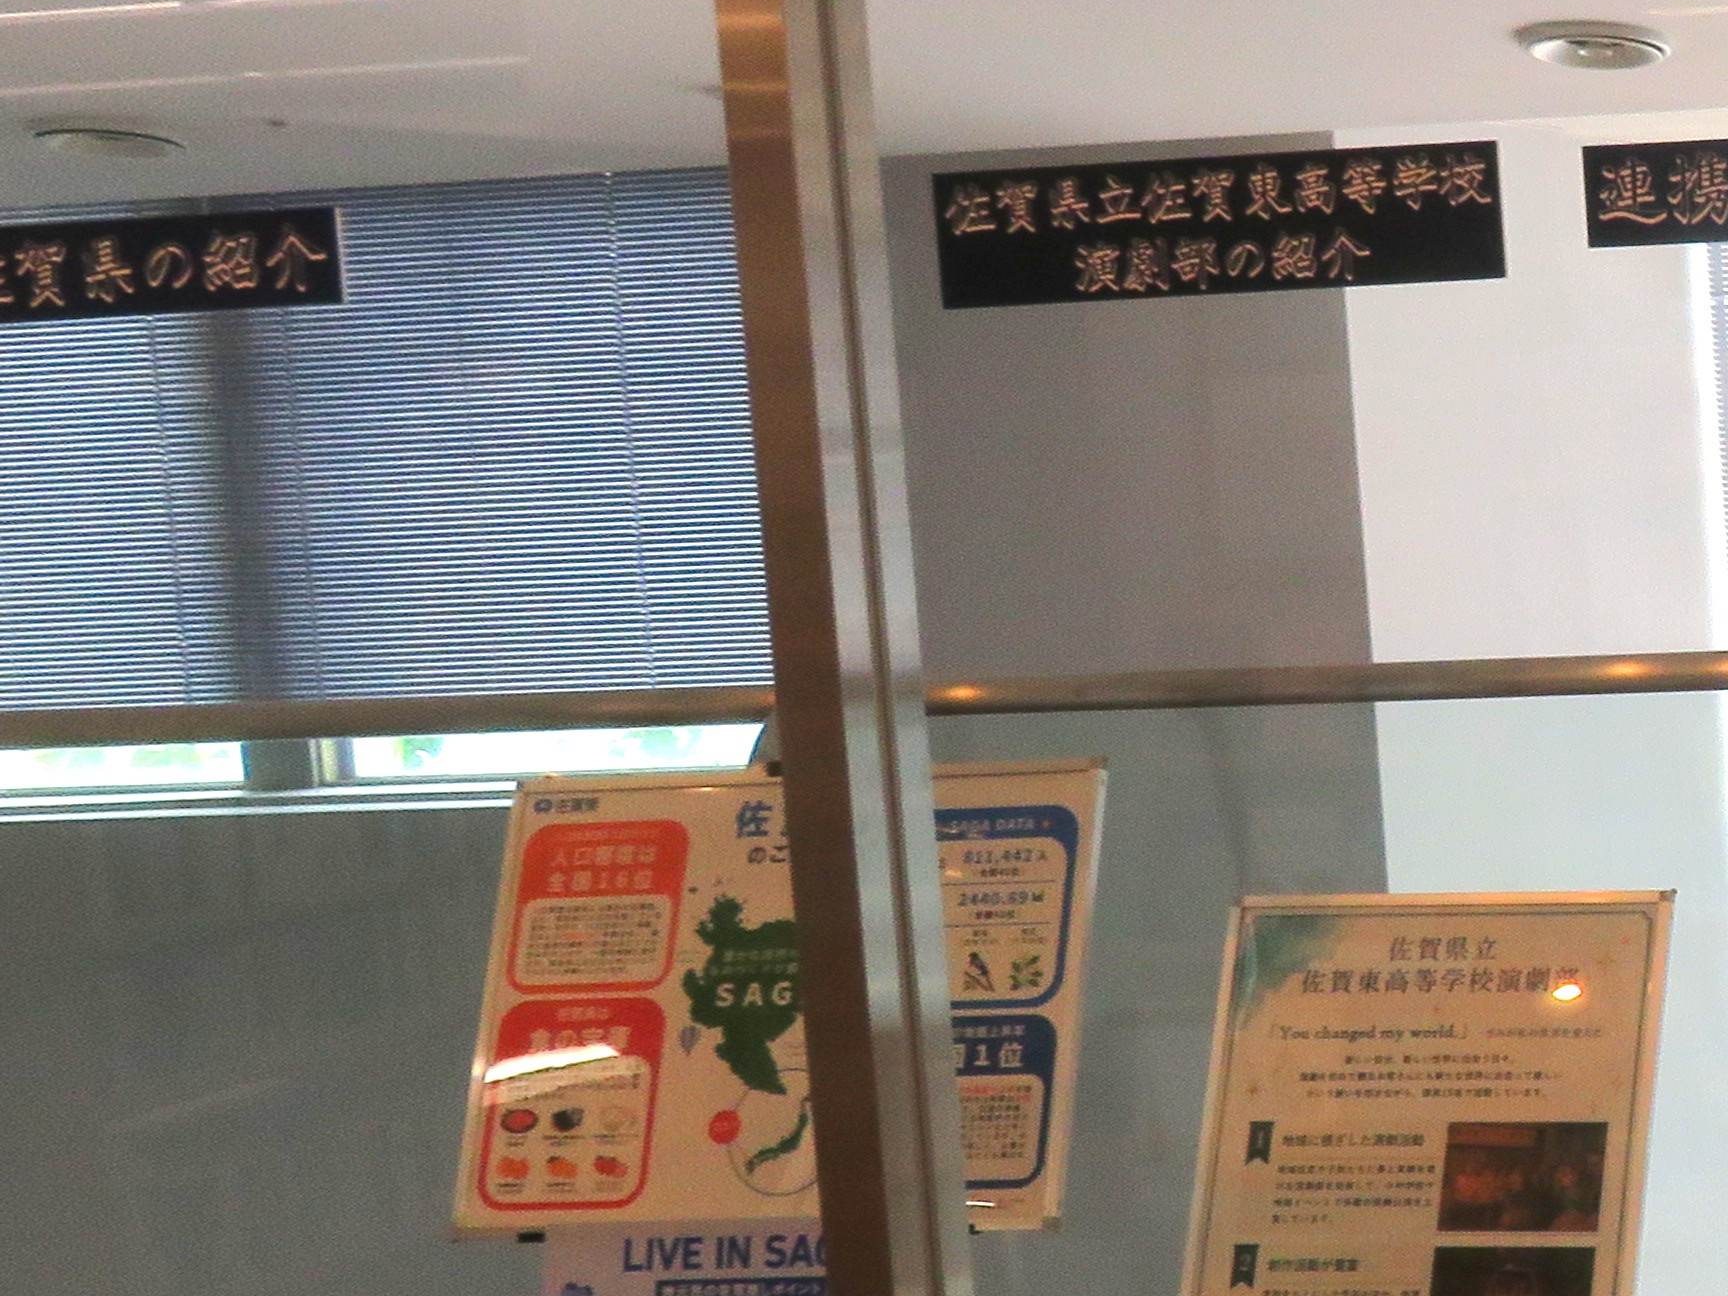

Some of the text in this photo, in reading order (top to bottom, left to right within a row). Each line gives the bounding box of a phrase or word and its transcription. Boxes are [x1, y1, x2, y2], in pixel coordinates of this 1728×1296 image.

[947, 154, 1493, 239] 佐賀県立佐賀東高等学校
[0, 229, 328, 309] 賀県の紹介
[1074, 233, 1372, 294] 演劇部の紹介
[1389, 936, 1496, 962] 佐賀県立
[1315, 1024, 1376, 1043] changed
[1381, 1027, 1405, 1043] my
[623, 1238, 702, 1272] LIVE
[715, 1236, 750, 1269] IN
